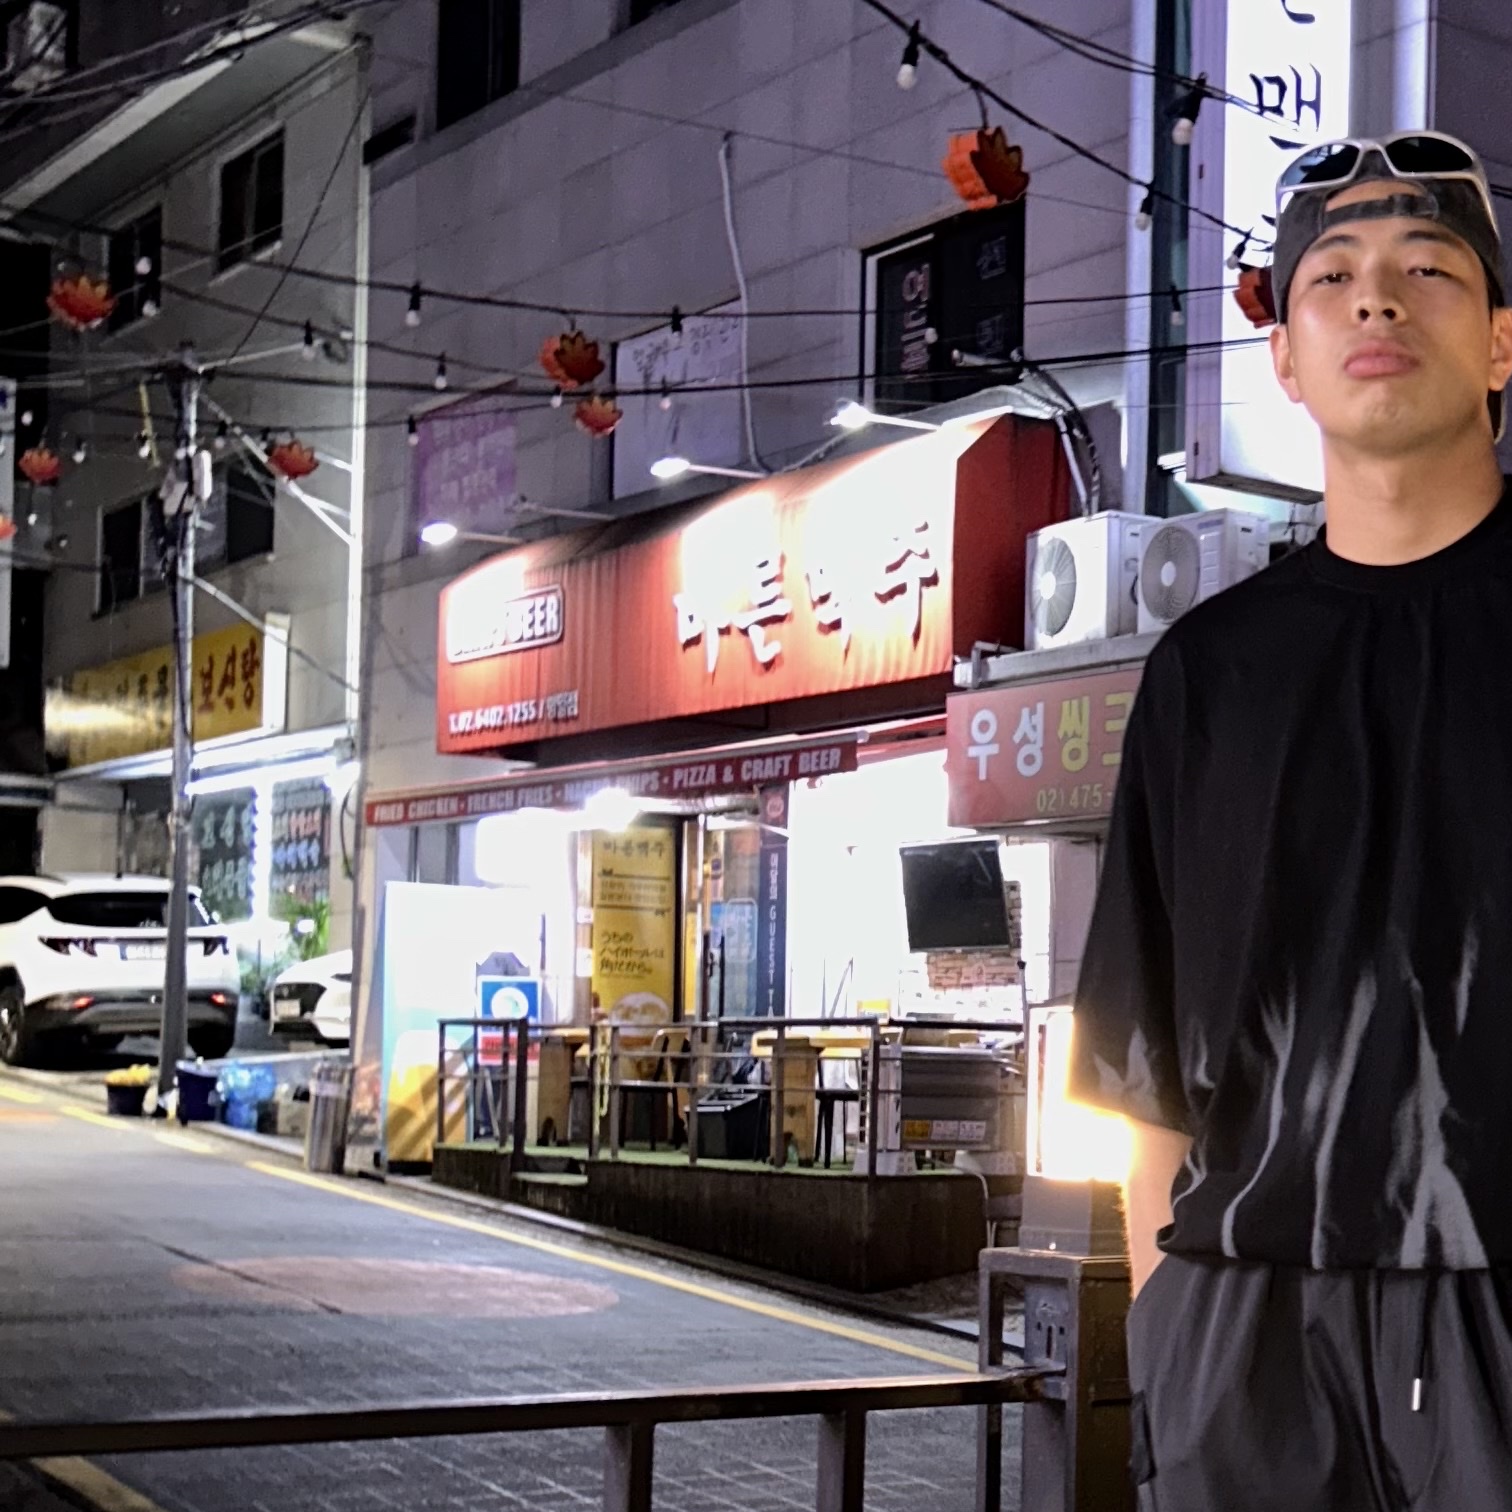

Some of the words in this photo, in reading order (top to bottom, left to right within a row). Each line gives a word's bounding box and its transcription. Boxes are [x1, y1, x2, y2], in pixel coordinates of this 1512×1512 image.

[968, 691, 1136, 781] 우성씽크
[374, 803, 405, 822] FRIED
[408, 798, 459, 819] CHICKEN
[467, 789, 514, 812] FRENCH
[517, 784, 553, 807] FRIES
[673, 764, 717, 788] PIZZA
[723, 765, 733, 782] &
[741, 755, 792, 781] CRAFT
[800, 748, 841, 771] BEER
[769, 905, 777, 985] GUEST
[767, 988, 775, 1018] TA
